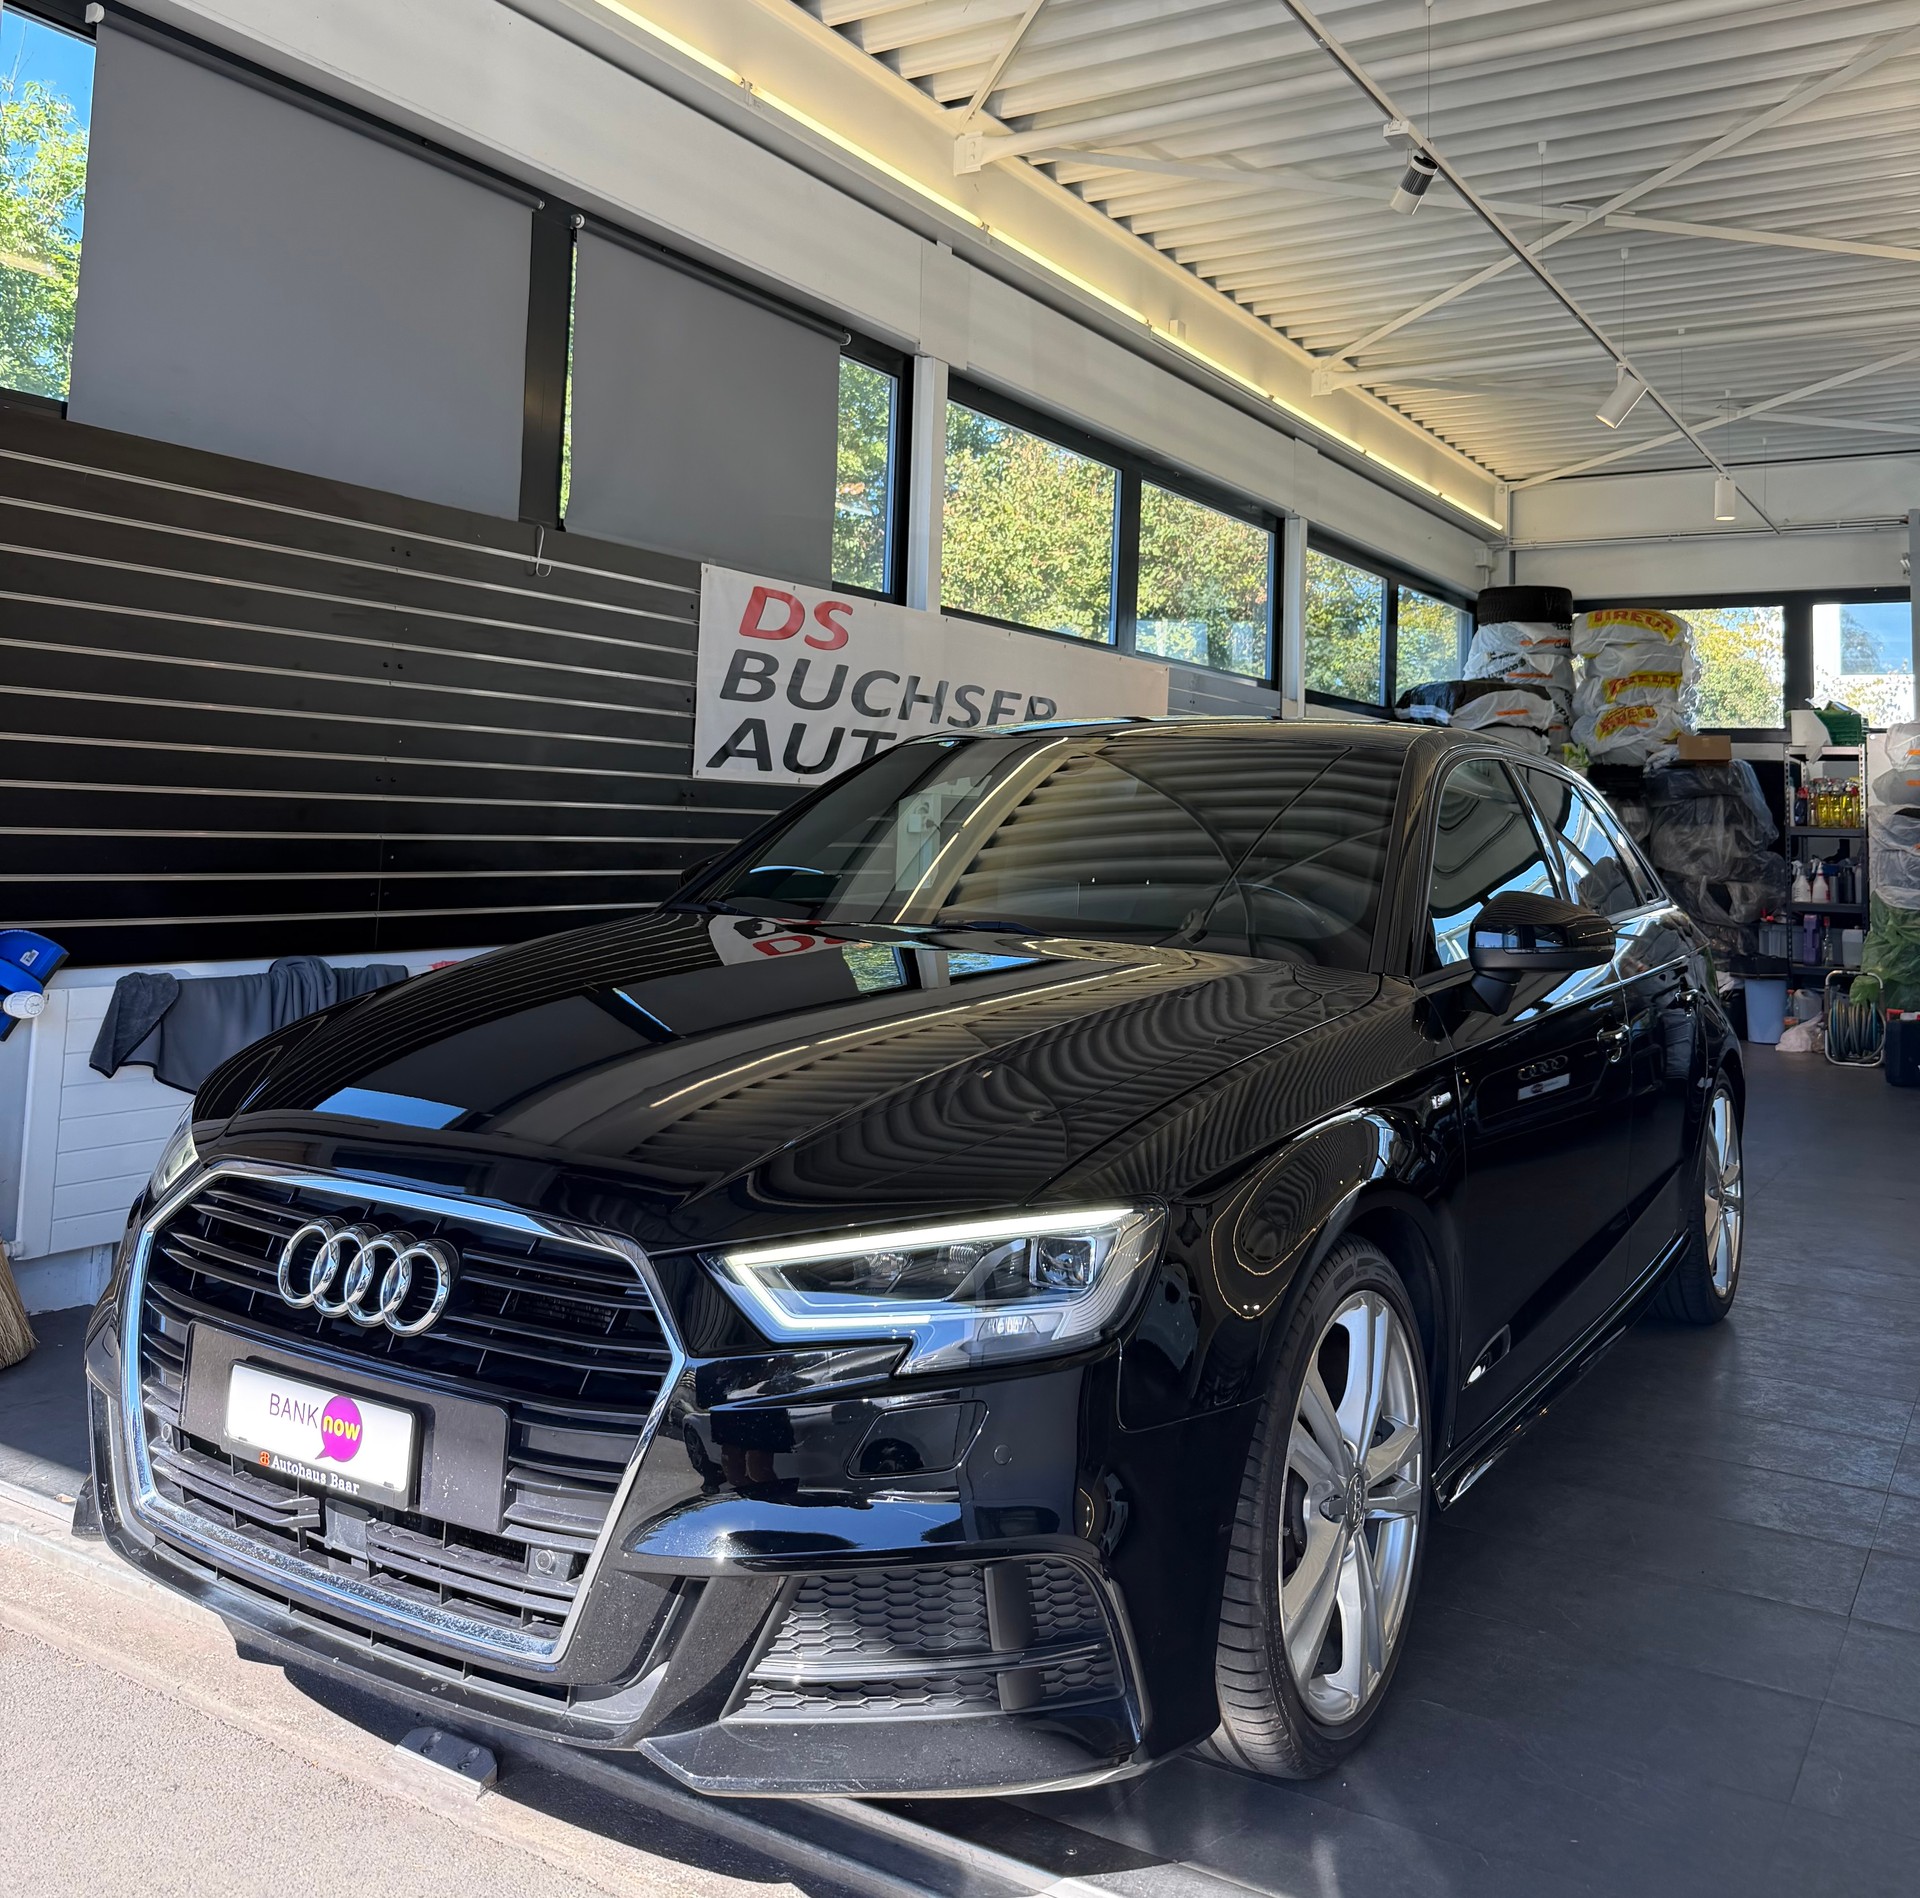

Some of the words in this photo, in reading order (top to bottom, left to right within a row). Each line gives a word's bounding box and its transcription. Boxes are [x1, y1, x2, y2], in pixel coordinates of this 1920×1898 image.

[738, 585, 854, 651] DS
[705, 717, 922, 775] AUT
[270, 1393, 319, 1428] BANK
[322, 1415, 361, 1441] now
[271, 1455, 327, 1484] Autohaus
[330, 1472, 360, 1495] Baar
